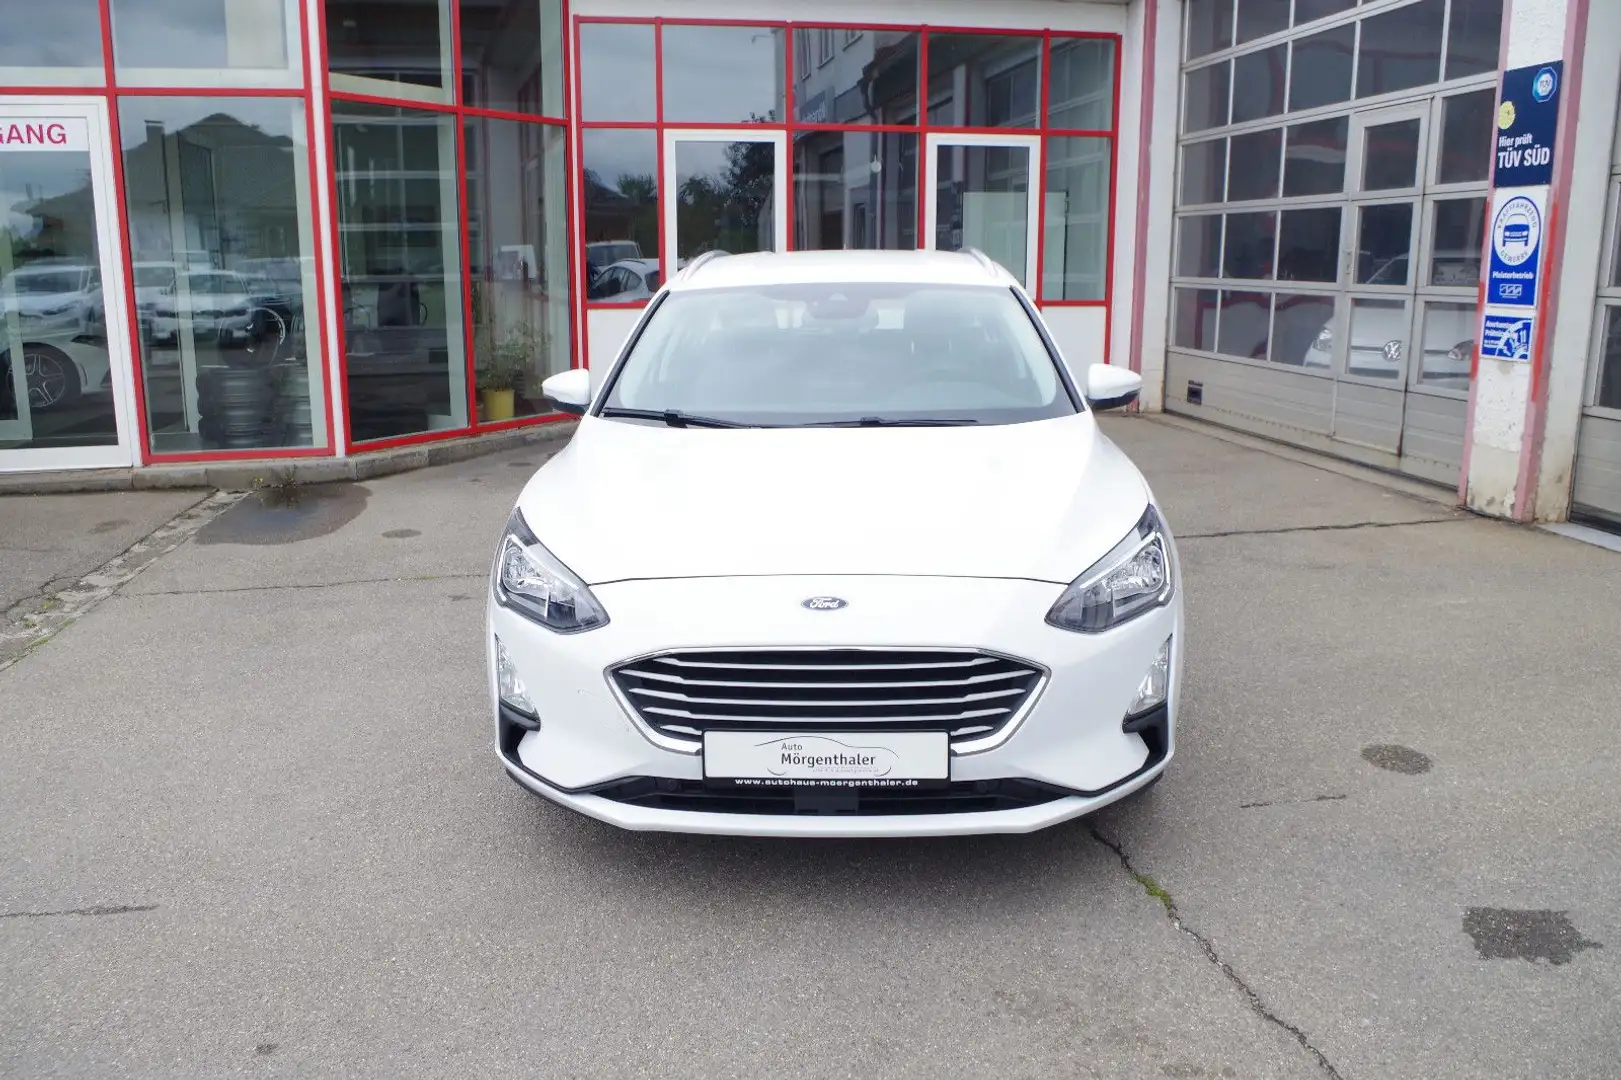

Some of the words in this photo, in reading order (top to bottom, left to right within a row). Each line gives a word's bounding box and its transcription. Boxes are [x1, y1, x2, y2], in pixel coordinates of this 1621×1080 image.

[1499, 136, 1514, 147] Hier
[1515, 133, 1533, 148] prüft
[1498, 147, 1522, 169] TÜV
[1523, 144, 1550, 166] SÜD
[1492, 271, 1534, 279] Meisterbetrieb
[810, 598, 840, 609] Ford
[781, 742, 803, 751] Auto
[781, 752, 876, 768] Mörgenthaler
[734, 778, 919, 788] www.autohaus-moergenthaler.de
